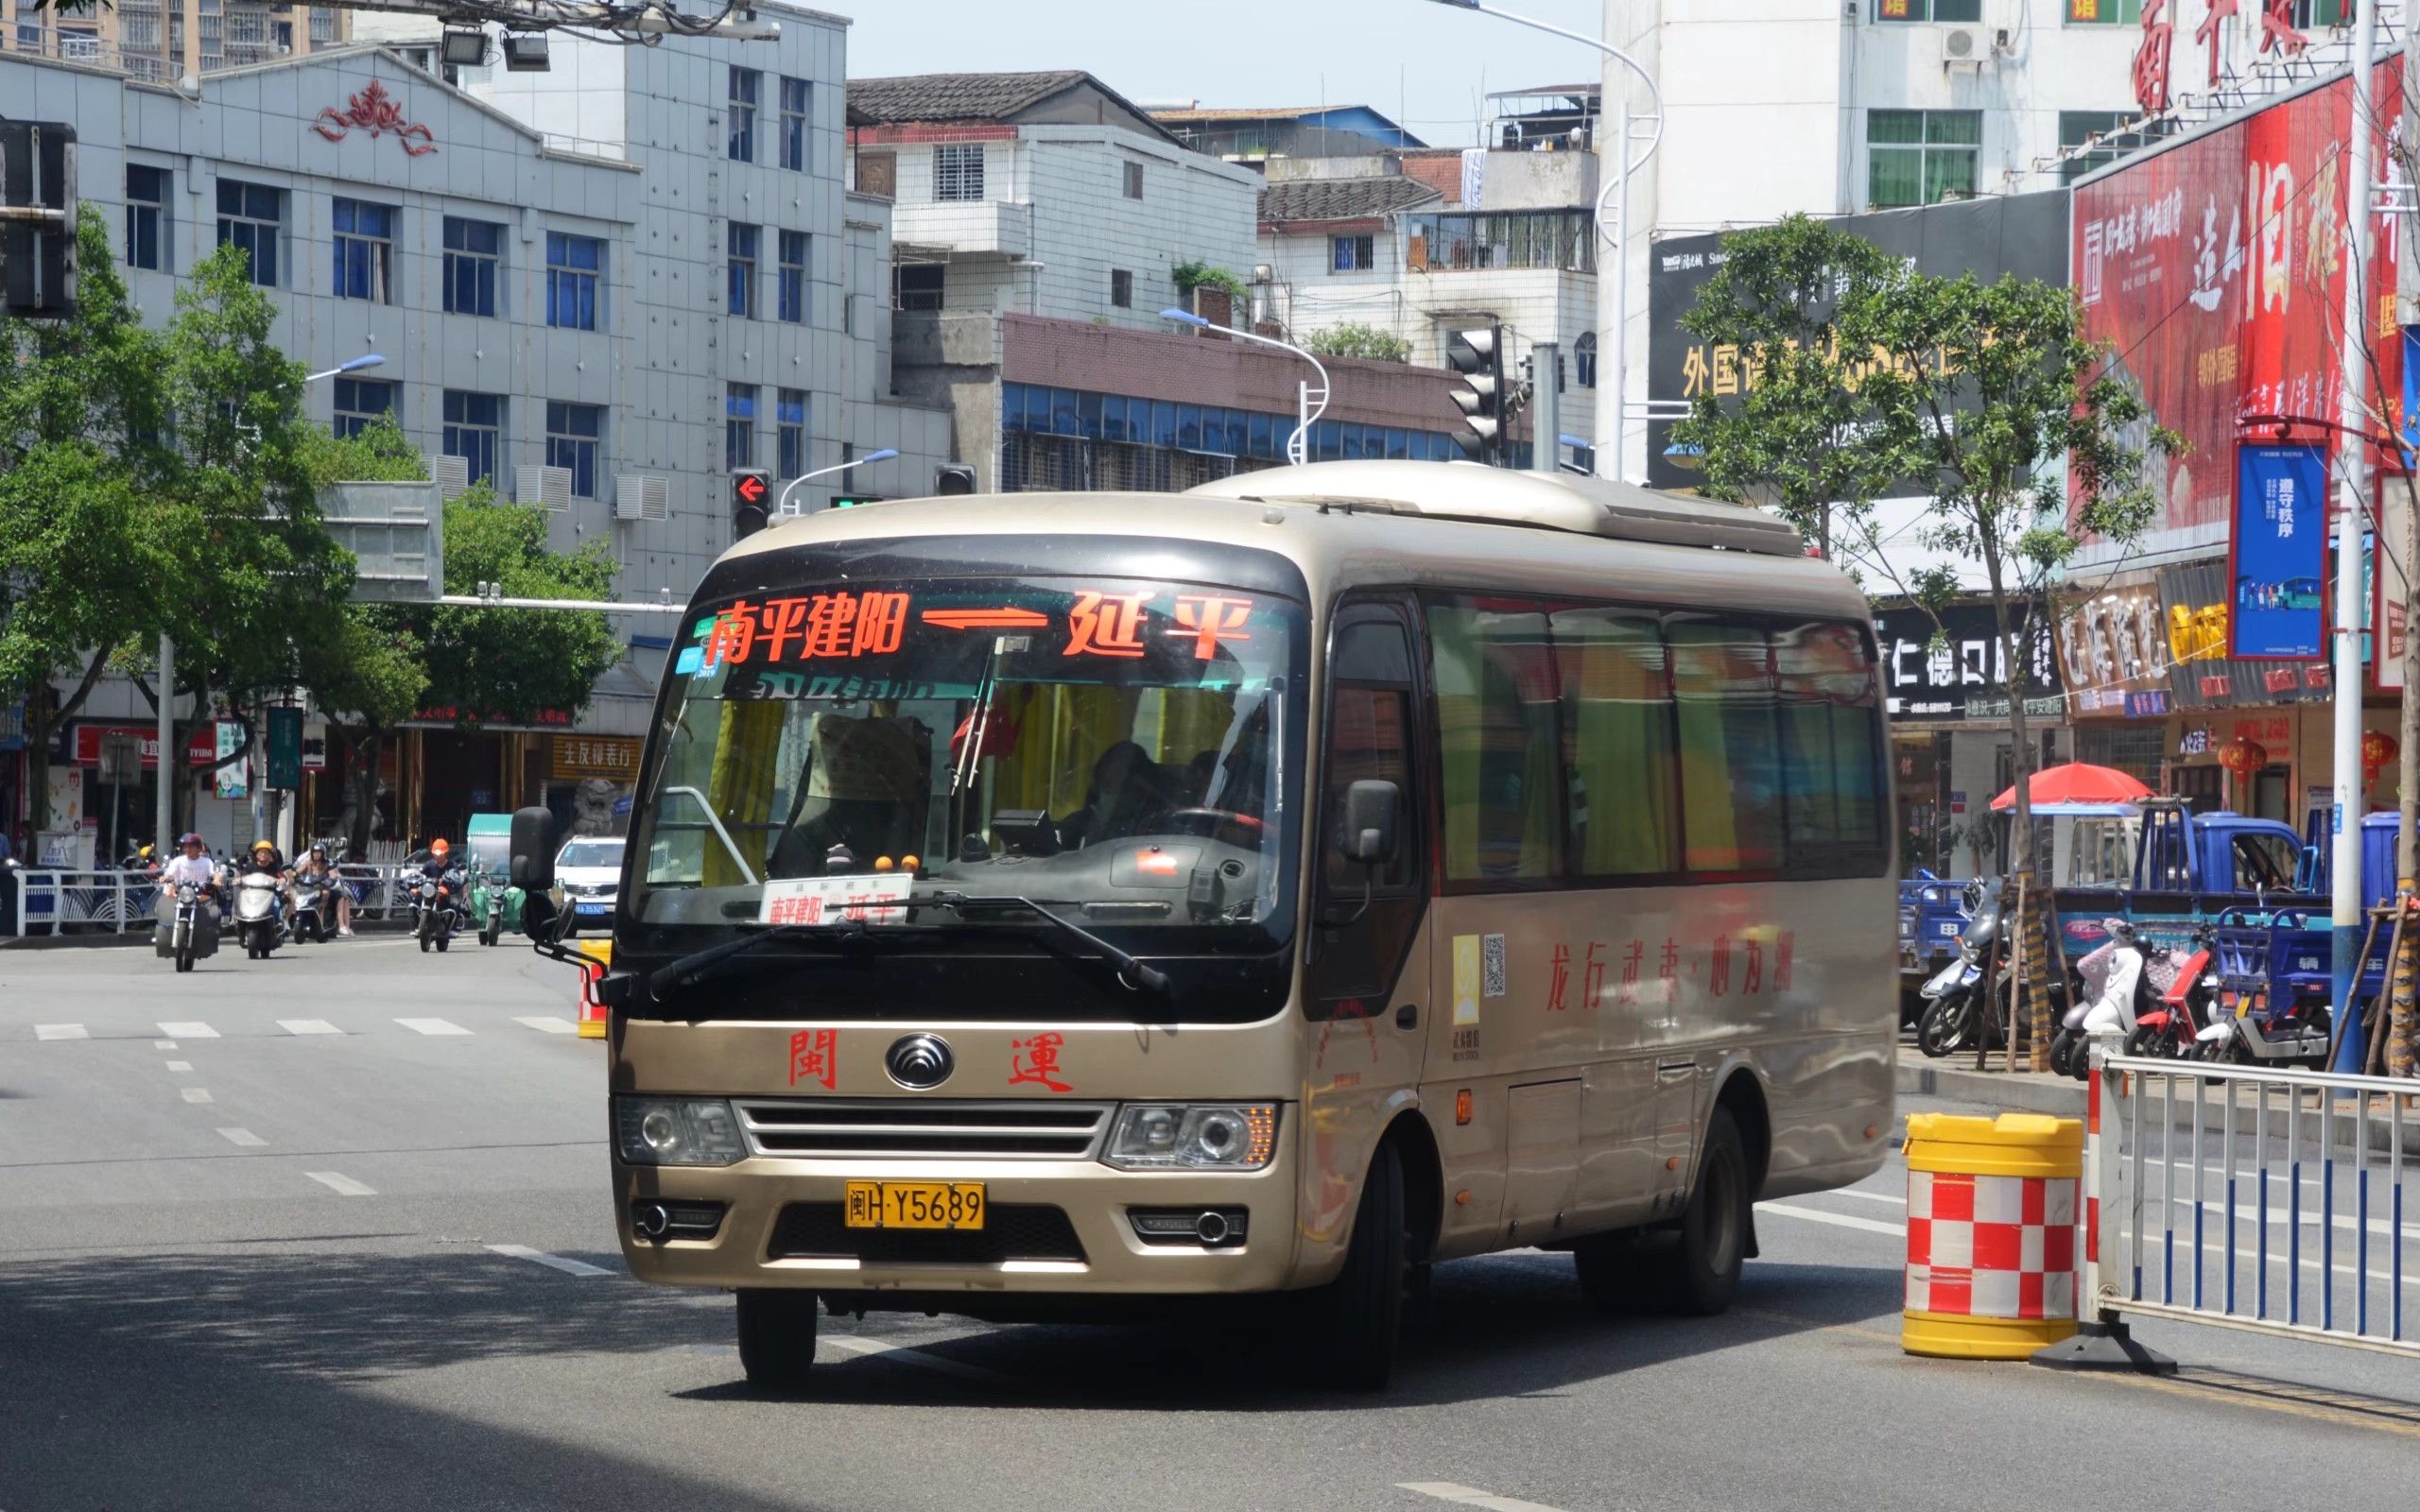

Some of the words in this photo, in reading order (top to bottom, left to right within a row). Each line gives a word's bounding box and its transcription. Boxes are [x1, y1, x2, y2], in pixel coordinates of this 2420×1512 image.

[2277, 477, 2295, 538] 遵守秩序
[705, 592, 911, 665] 南平建阳
[1062, 591, 1253, 661] 延平
[770, 895, 822, 924] 南平建阳
